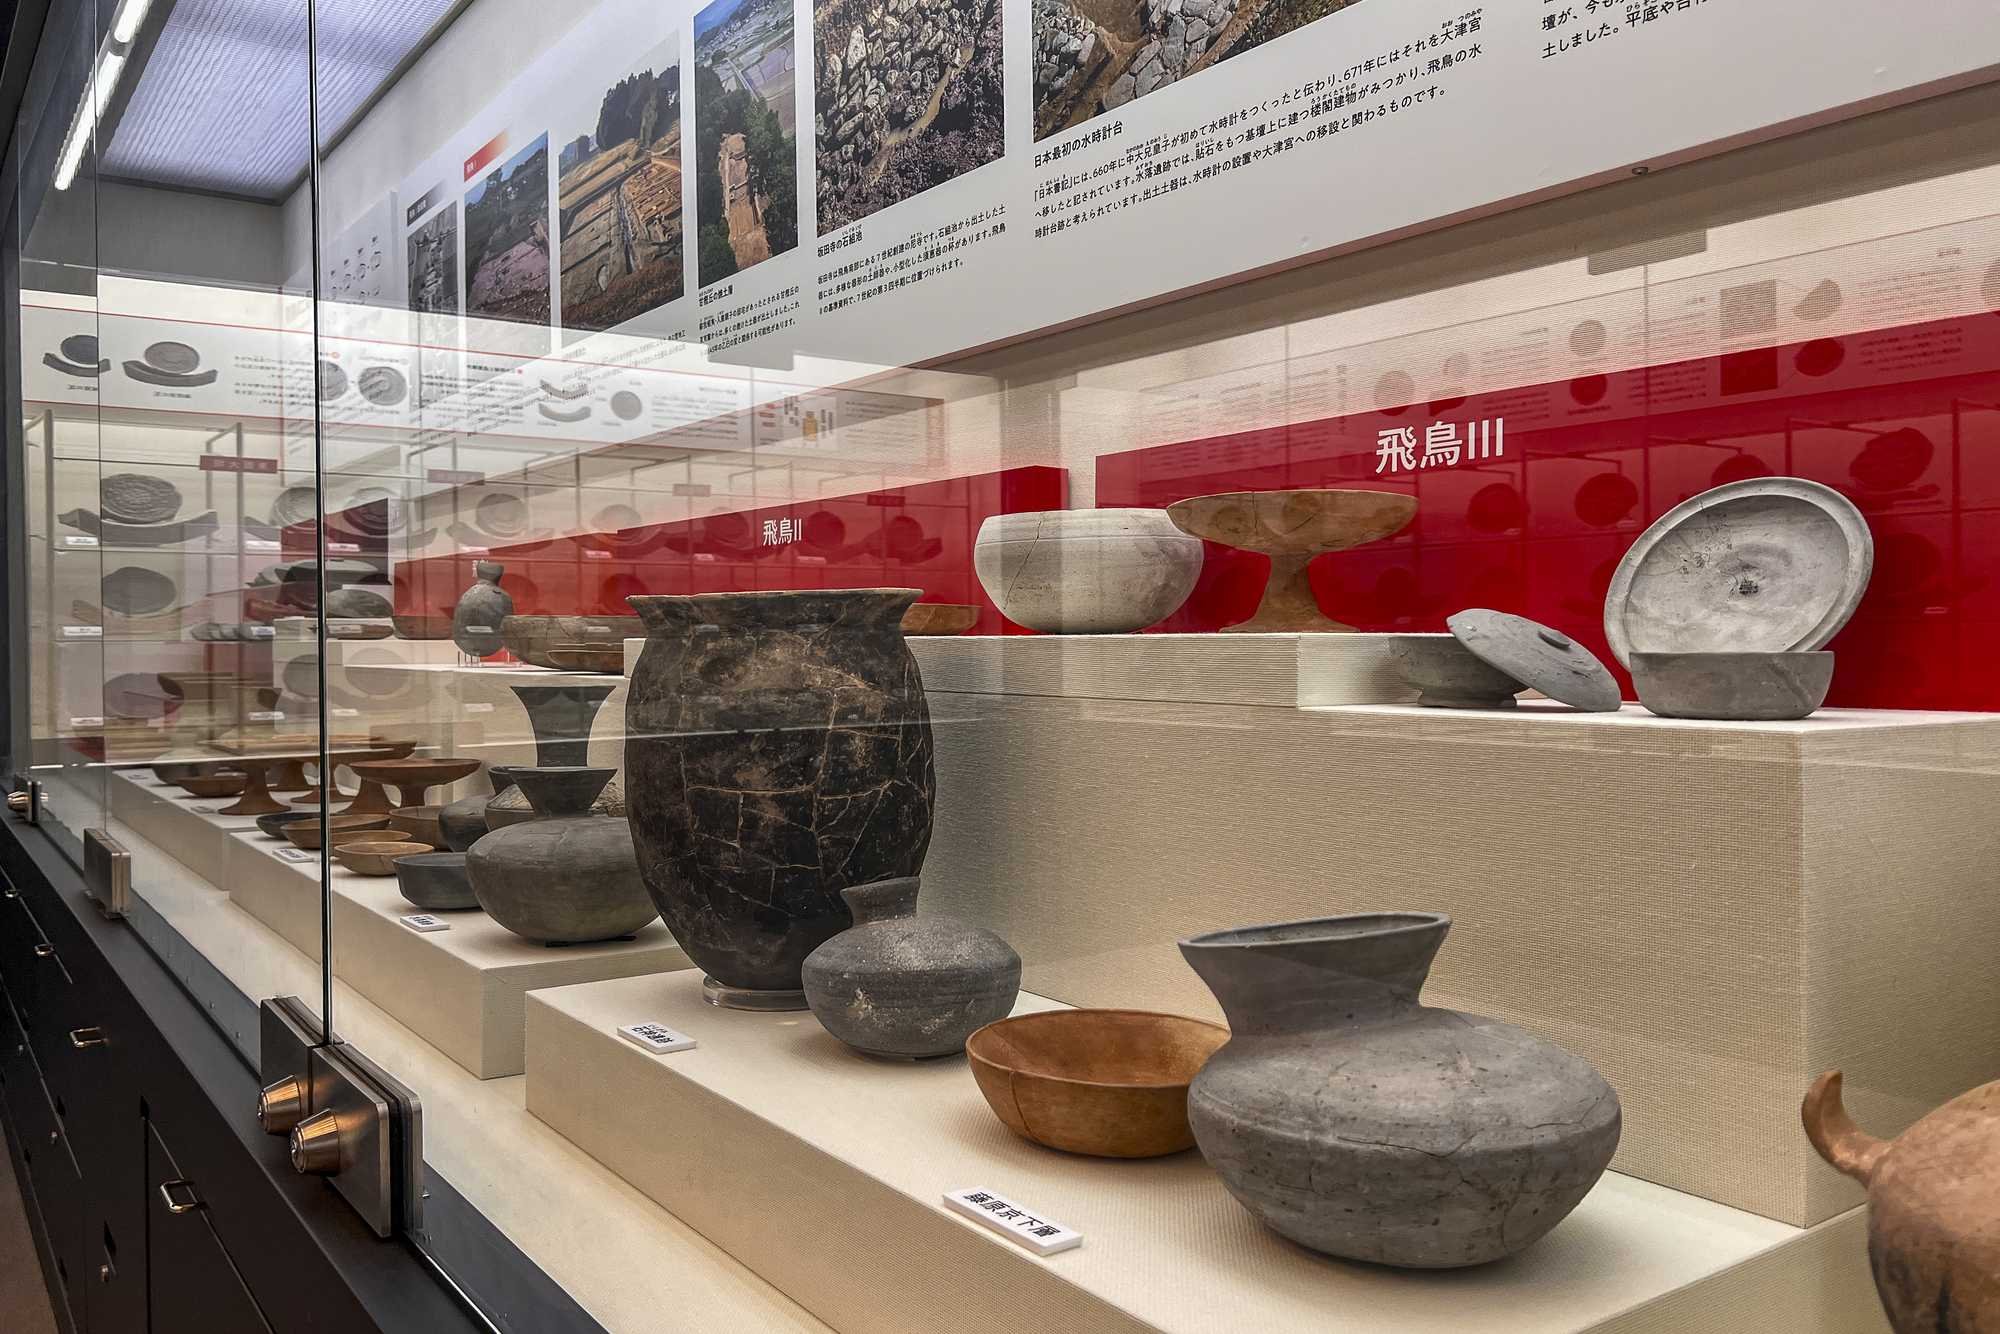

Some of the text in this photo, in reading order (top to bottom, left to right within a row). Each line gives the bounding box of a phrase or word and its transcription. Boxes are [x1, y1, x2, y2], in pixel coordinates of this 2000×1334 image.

[1541, 0, 1625, 31] 壇が、今も
[1542, 0, 1707, 59] 土しました。平底や台
[1033, 120, 1123, 169] 日本最初の水時計台
[817, 230, 863, 258] 坂田寺の石組池
